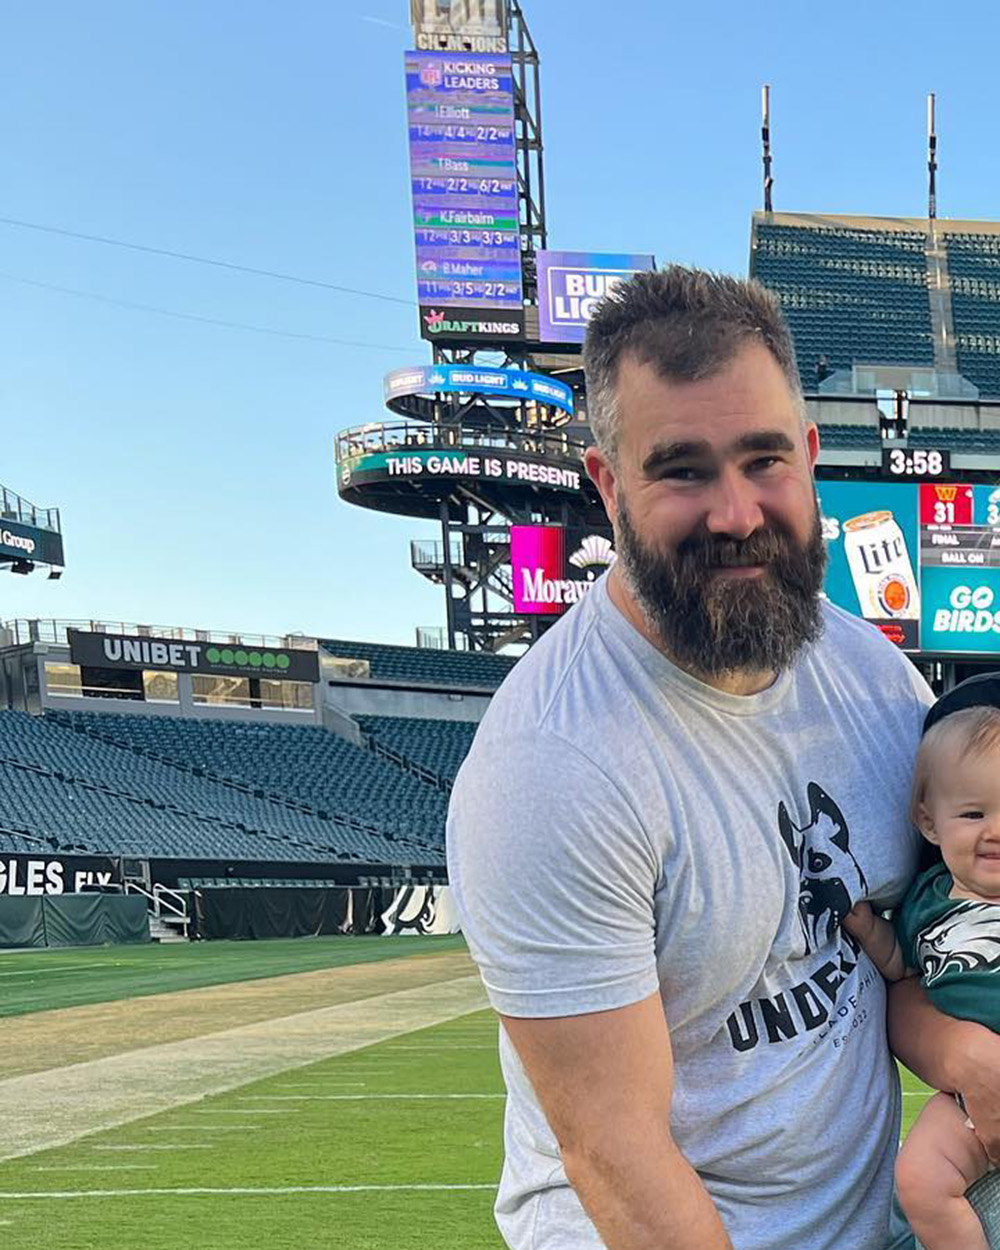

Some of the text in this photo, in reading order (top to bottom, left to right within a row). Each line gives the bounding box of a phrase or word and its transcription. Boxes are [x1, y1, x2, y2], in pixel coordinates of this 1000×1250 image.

[443, 62, 497, 75] KICKING
[444, 76, 500, 90] LEADERS
[477, 127, 498, 140] 2/2
[450, 230, 471, 243] 3/3
[482, 231, 503, 245] 3/3
[453, 282, 474, 294] 3/5
[484, 283, 505, 296] 2/2
[427, 319, 520, 335] DRAFTKINGS
[452, 373, 505, 386] BUD LIGHT
[890, 449, 943, 475] 3:58
[386, 457, 581, 490] THIS GAME IS PRESENTE
[934, 501, 955, 523] 31
[3, 530, 35, 554] Group
[932, 533, 960, 546] FINAL
[942, 551, 985, 565] BALL ON
[521, 567, 596, 605] Morav
[950, 585, 995, 610] GO
[103, 639, 201, 668] UNIBET
